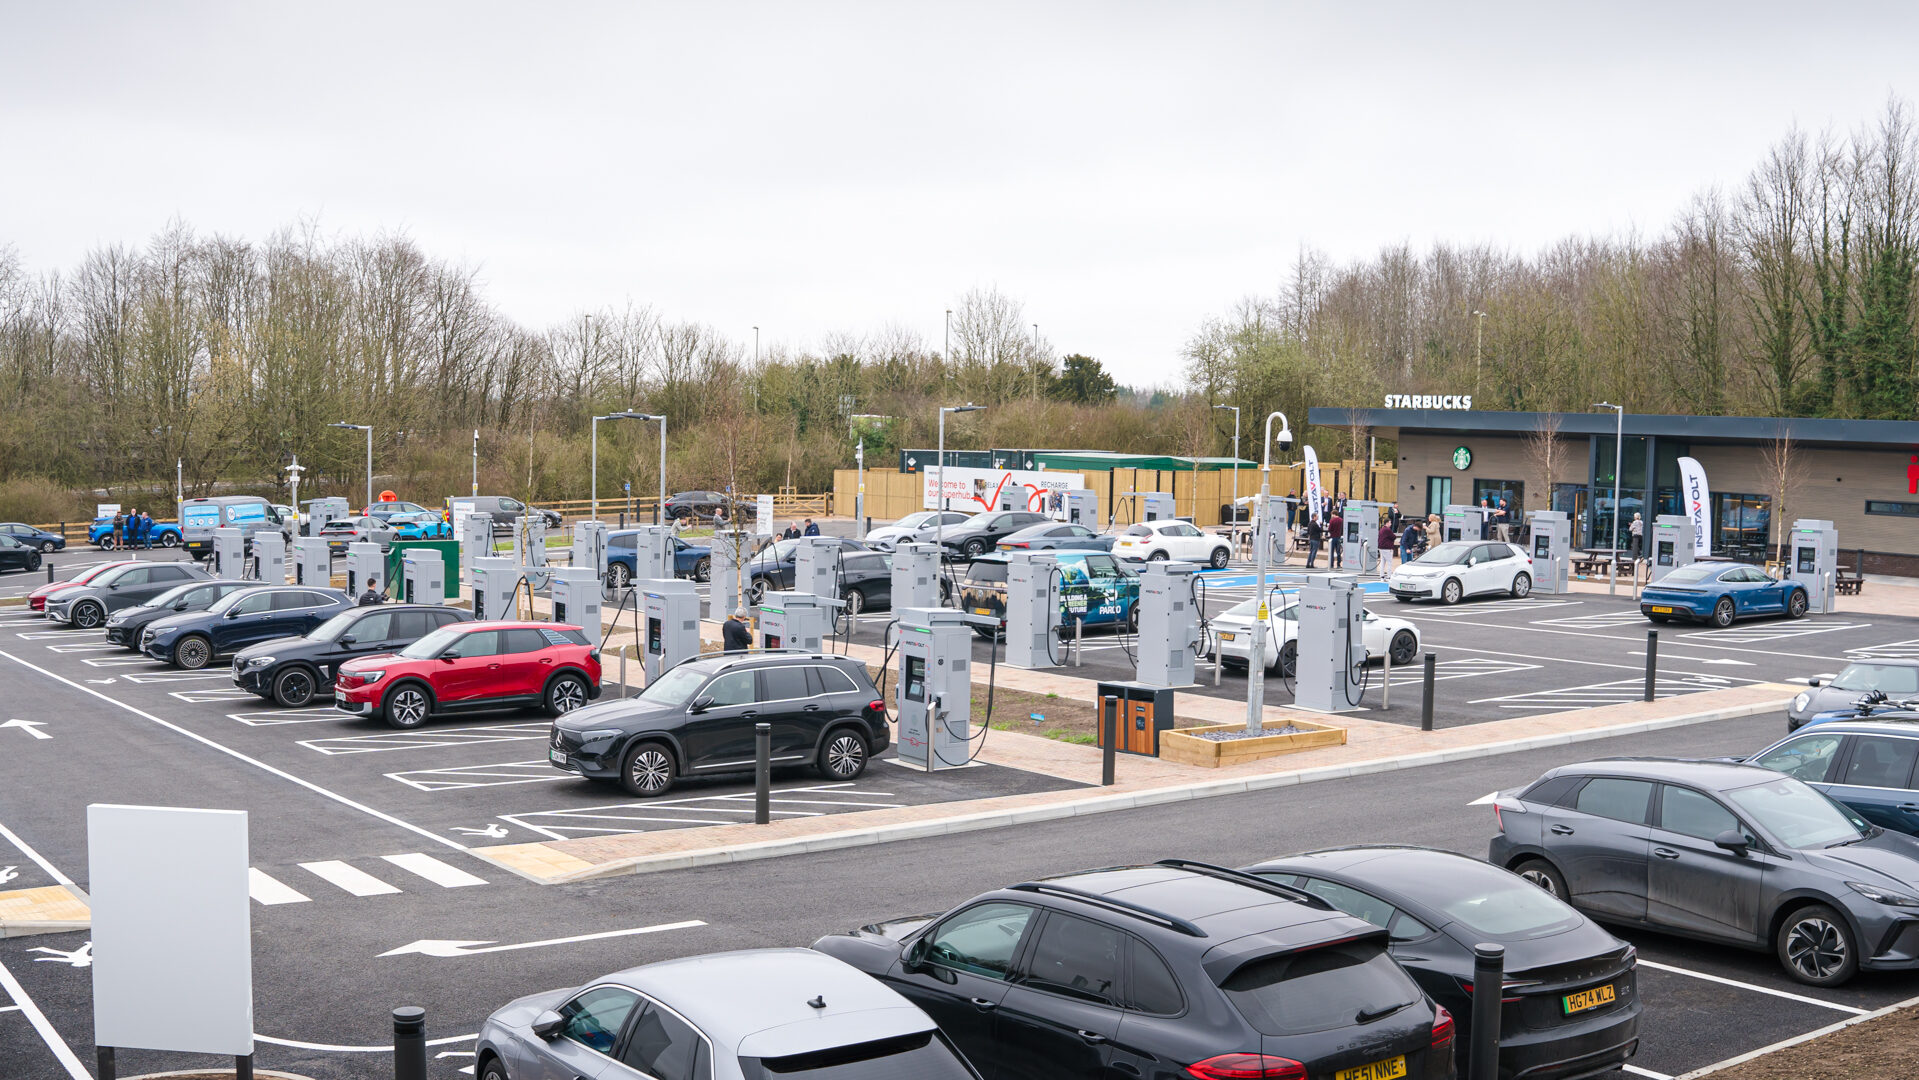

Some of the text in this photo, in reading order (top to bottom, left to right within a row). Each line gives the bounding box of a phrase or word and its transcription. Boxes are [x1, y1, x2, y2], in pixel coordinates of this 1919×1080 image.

[1384, 394, 1472, 410] STARBUCKS
[928, 479, 966, 490] Weome to
[1041, 481, 1069, 489] RECHARGE
[1308, 460, 1319, 514] STAVOLT
[1689, 475, 1703, 548] INSTAVOLT
[1568, 991, 1595, 1010] HG74
[1595, 986, 1614, 1003] WLZ
[1375, 1059, 1399, 1079] NNE
